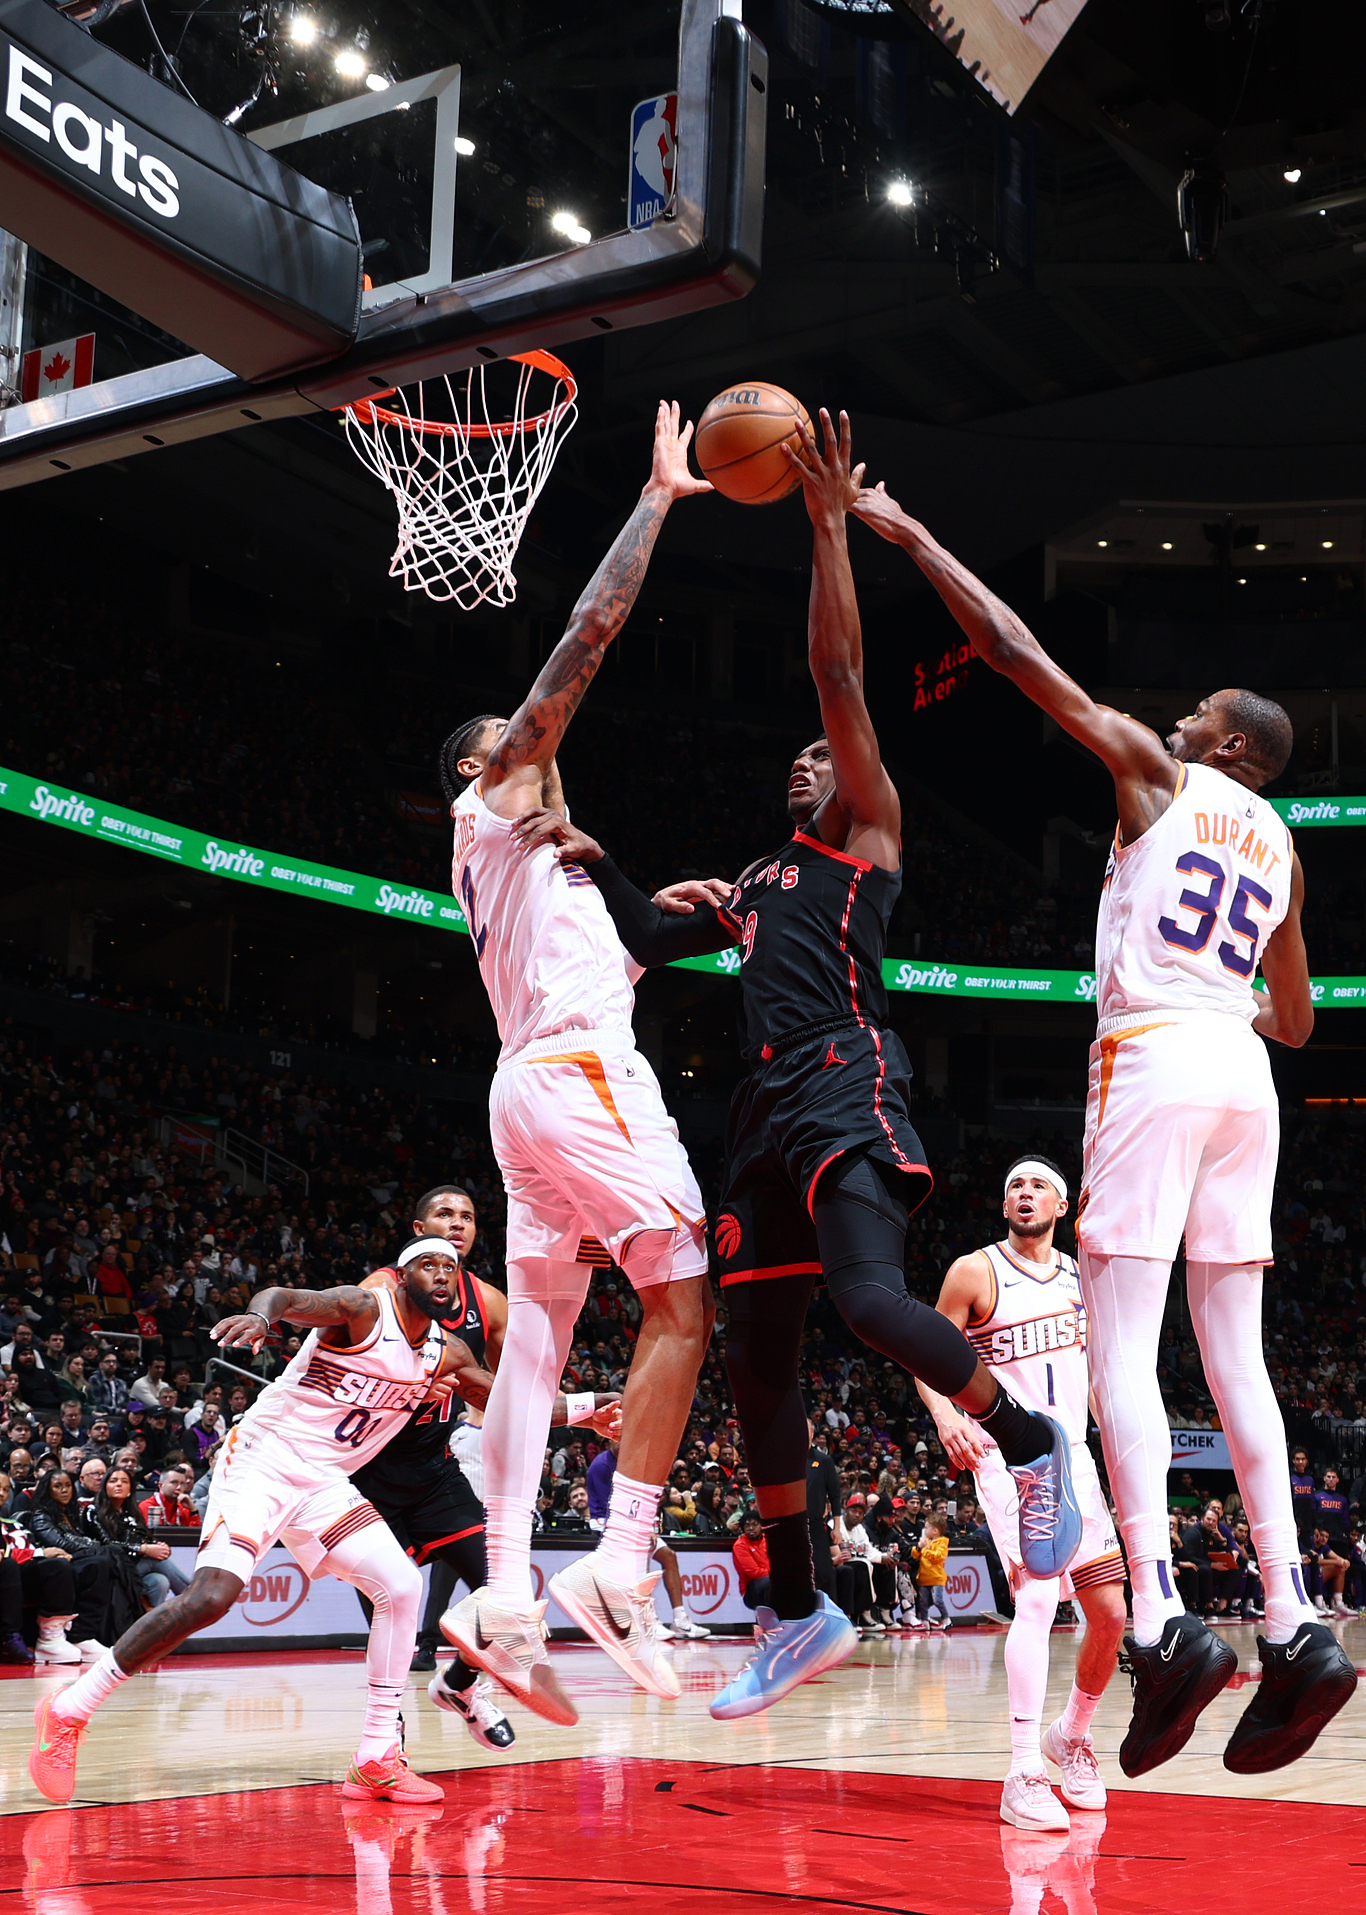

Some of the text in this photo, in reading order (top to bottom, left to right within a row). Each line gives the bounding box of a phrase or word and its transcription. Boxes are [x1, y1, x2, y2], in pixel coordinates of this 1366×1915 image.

[6, 43, 181, 219] Eats
[636, 199, 660, 225] NBA
[913, 669, 969, 712] Arena
[29, 785, 96, 827] Sprite
[101, 815, 126, 834] OBEY
[126, 823, 151, 842] YOUR
[150, 831, 184, 851] THIRST
[1287, 801, 1341, 823] Sprite
[1194, 812, 1282, 878] DURANT
[201, 841, 356, 896] Sprite OBEY YOUR THIRST
[375, 884, 464, 922] Sprite OBEY
[1158, 850, 1273, 981] 35
[895, 963, 1053, 991] Sprite OBEY YOUR THIRST
[1333, 987, 1361, 998] OBEY
[270, 1050, 291, 1067] 121
[1046, 1362, 1057, 1407] 1
[334, 1408, 383, 1448] 00
[1171, 1433, 1216, 1449] TCHEK
[681, 1574, 719, 1597] CDW
[945, 1575, 972, 1594] CDW
